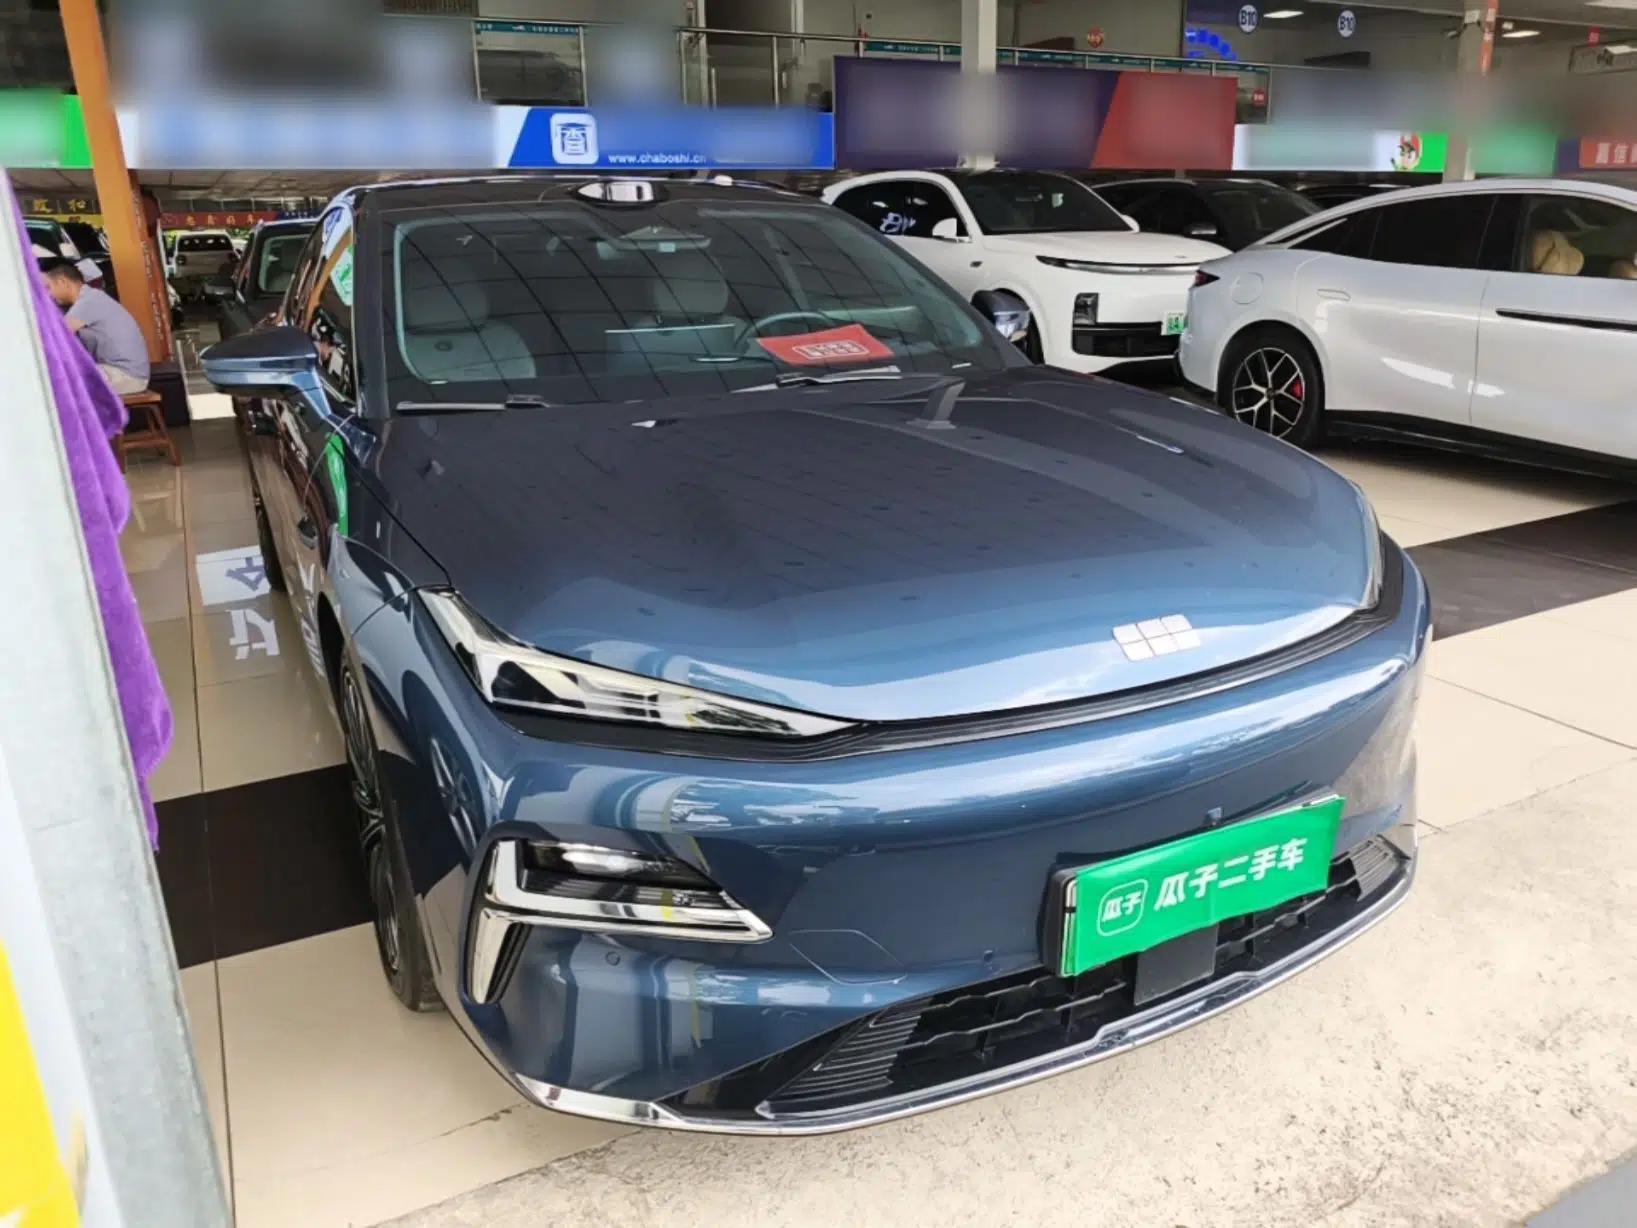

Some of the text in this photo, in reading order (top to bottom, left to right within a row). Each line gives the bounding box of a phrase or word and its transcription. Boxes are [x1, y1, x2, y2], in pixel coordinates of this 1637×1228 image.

[1240, 9, 1259, 27] B10
[1153, 837, 1308, 912] 瓜子二手车
[1101, 891, 1143, 922] 瓜子
